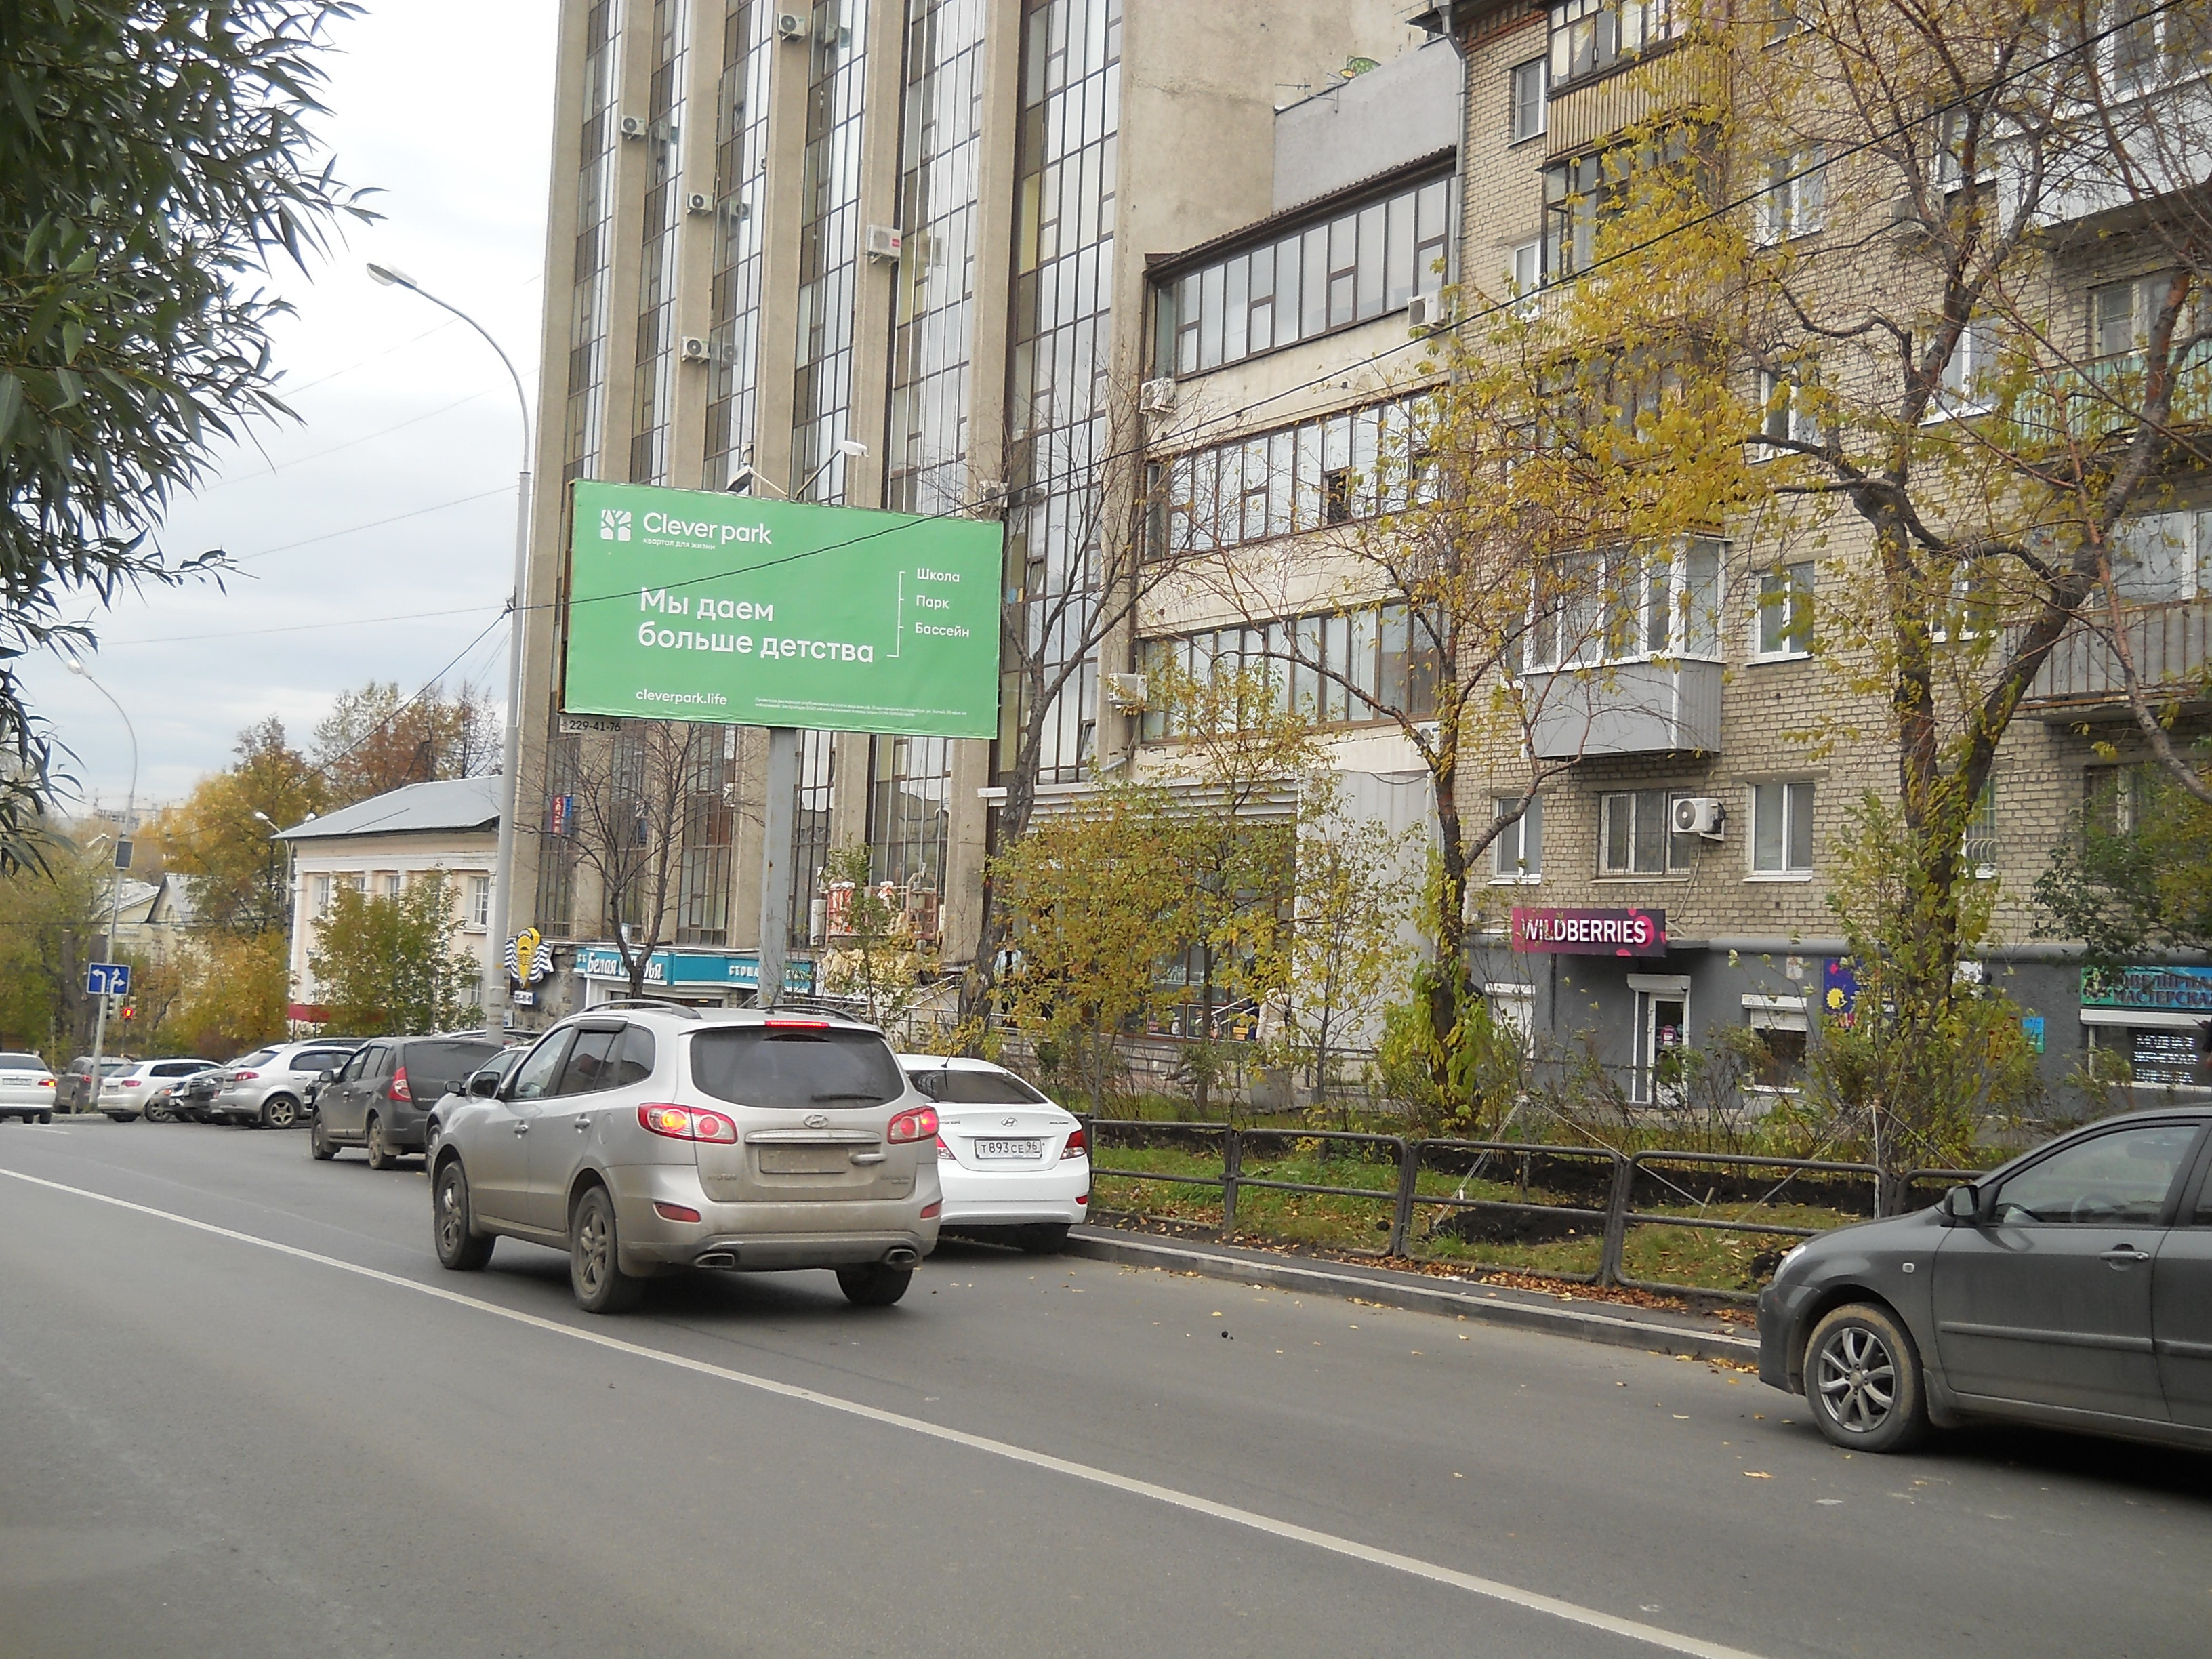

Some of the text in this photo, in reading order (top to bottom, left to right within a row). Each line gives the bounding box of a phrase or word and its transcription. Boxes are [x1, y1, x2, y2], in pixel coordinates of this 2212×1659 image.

[643, 512, 773, 545] Clever park
[643, 537, 675, 547] квартал
[691, 542, 716, 550] жизни
[916, 567, 960, 583] Школа
[640, 587, 774, 621] Мы даем
[916, 594, 949, 611] Парк
[915, 621, 970, 638] Бассейн
[638, 621, 874, 663] больше детства
[636, 689, 728, 705] cleverpark.life
[569, 720, 621, 732] 229-41-76
[1521, 918, 1647, 944] WILDBERRIES
[587, 951, 617, 975] Белая
[2113, 989, 2212, 1004] МАСТЕРСКА
